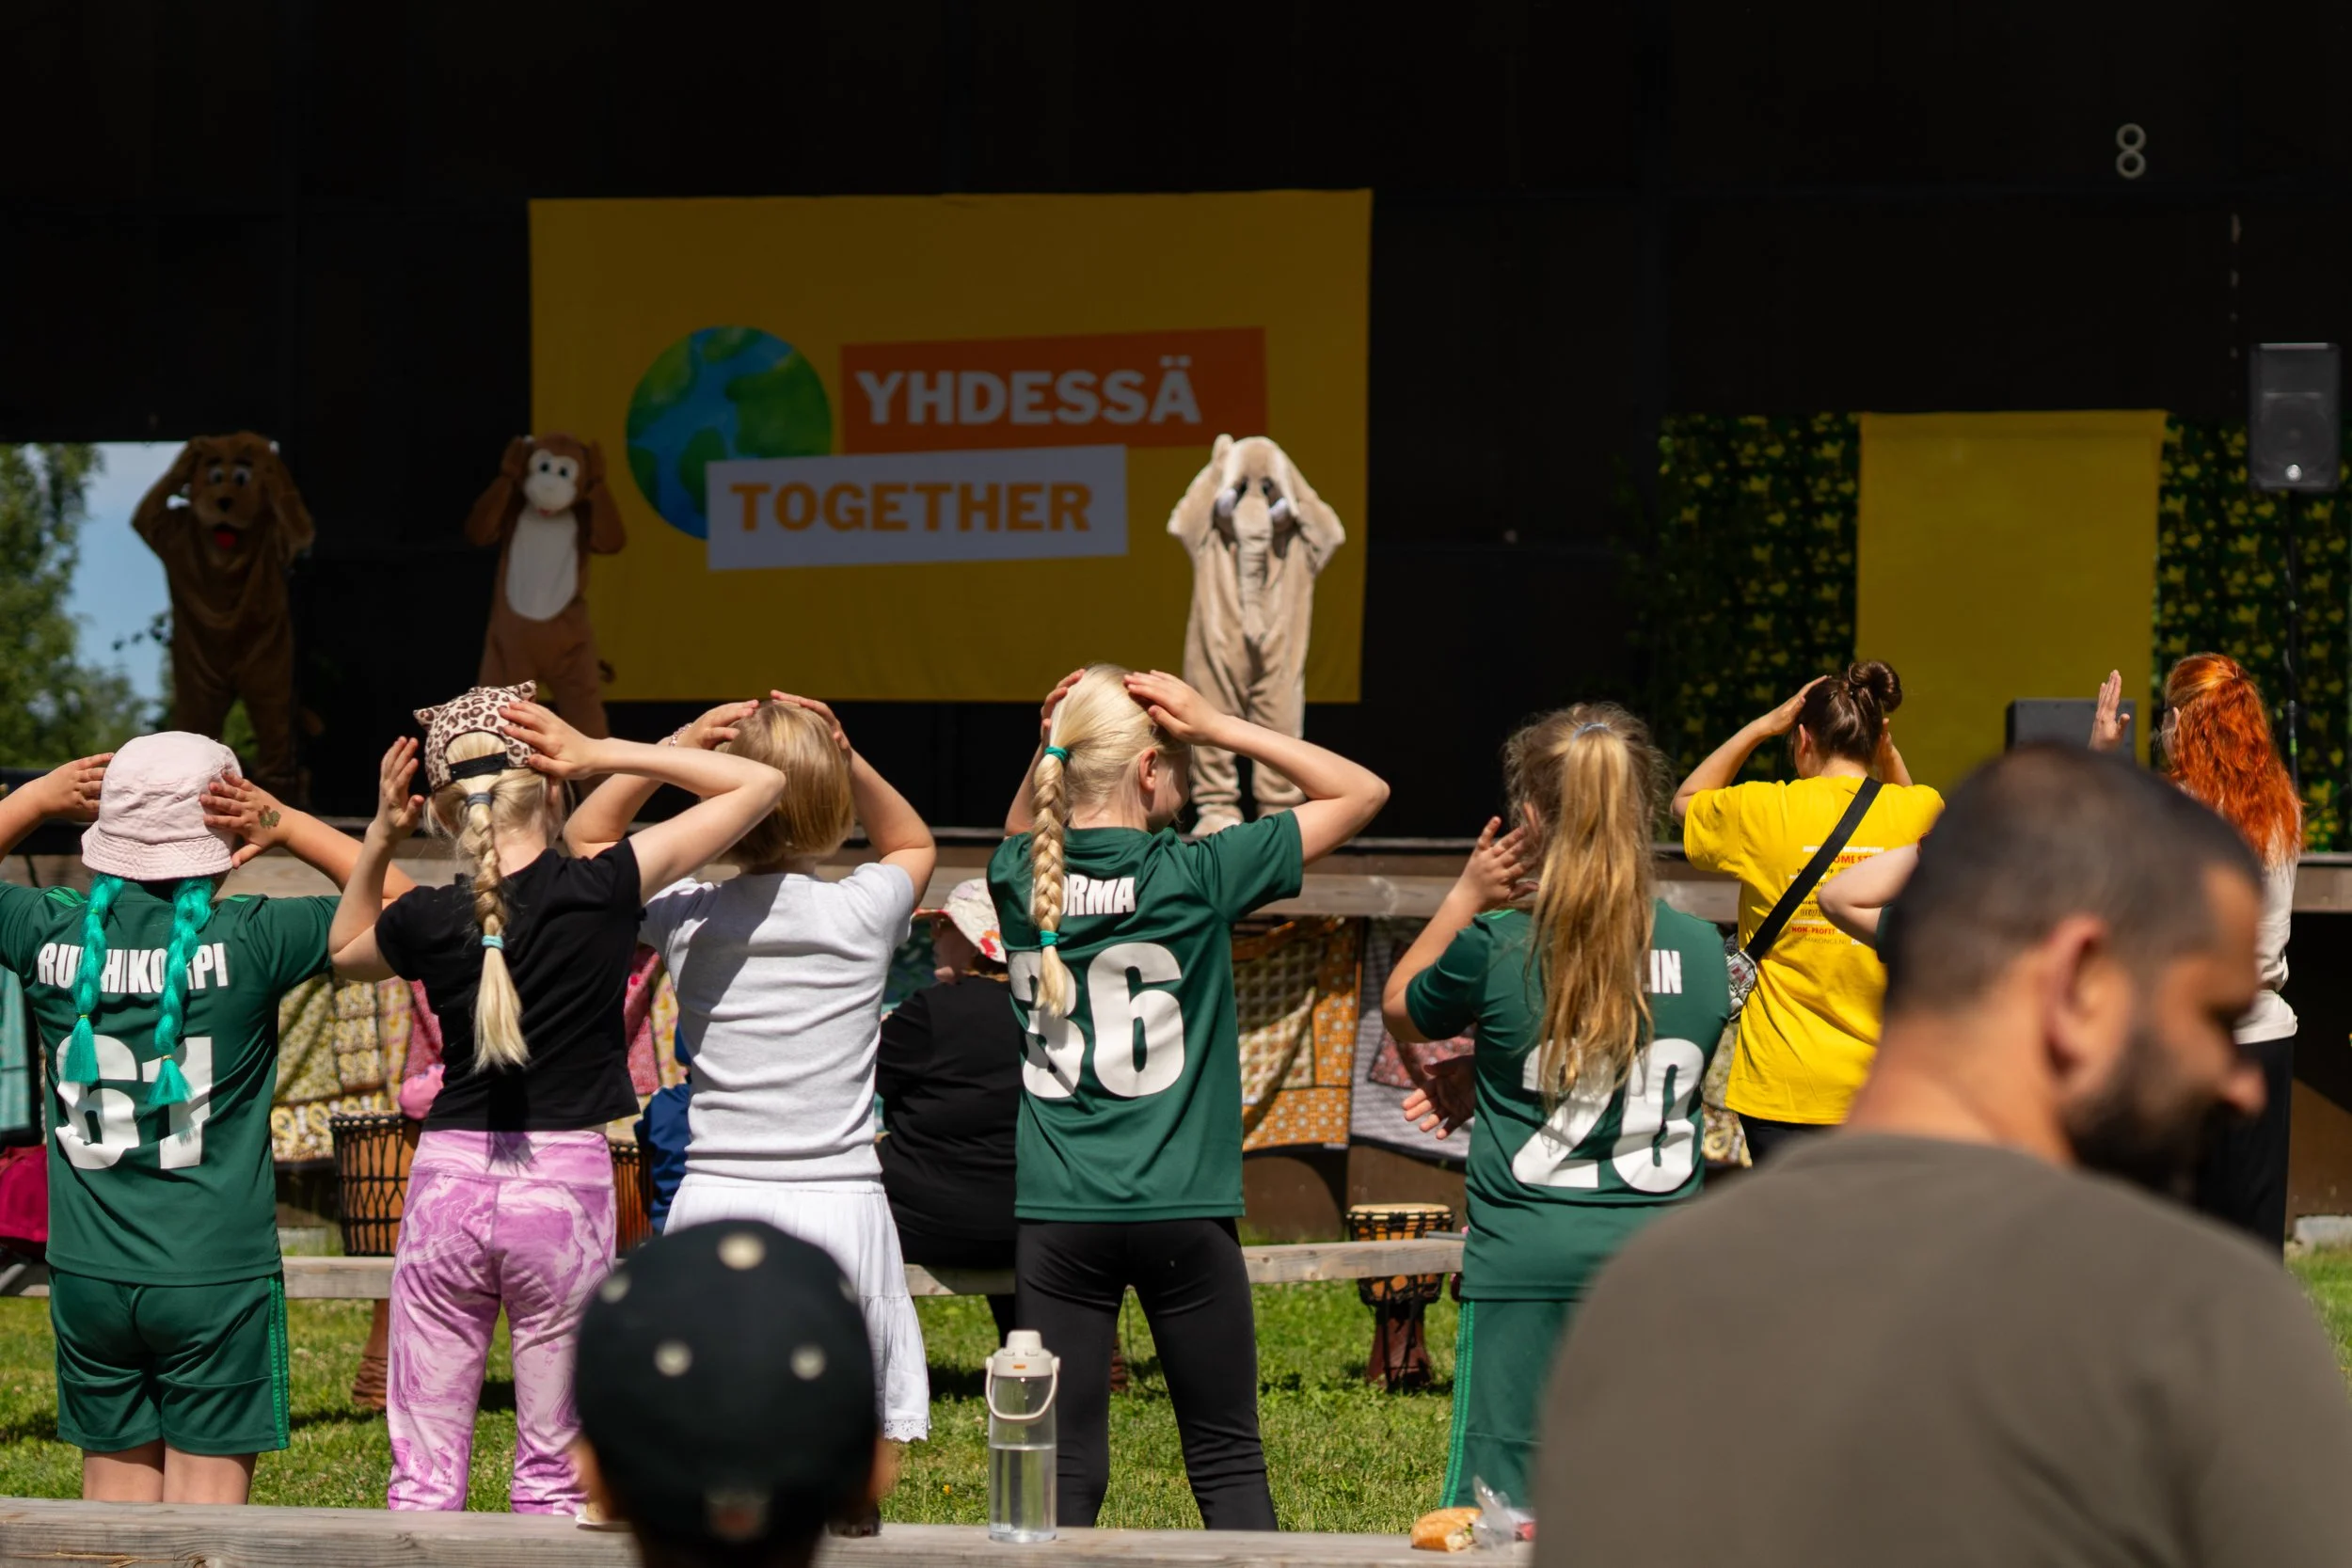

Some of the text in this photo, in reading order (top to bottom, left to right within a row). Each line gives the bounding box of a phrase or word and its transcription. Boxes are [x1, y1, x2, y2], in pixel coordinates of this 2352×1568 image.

[2116, 123, 2146, 179] 8
[854, 354, 1202, 426] YHDESSÄ
[730, 481, 1092, 533] TOGETHER
[55, 1034, 213, 1169] 61
